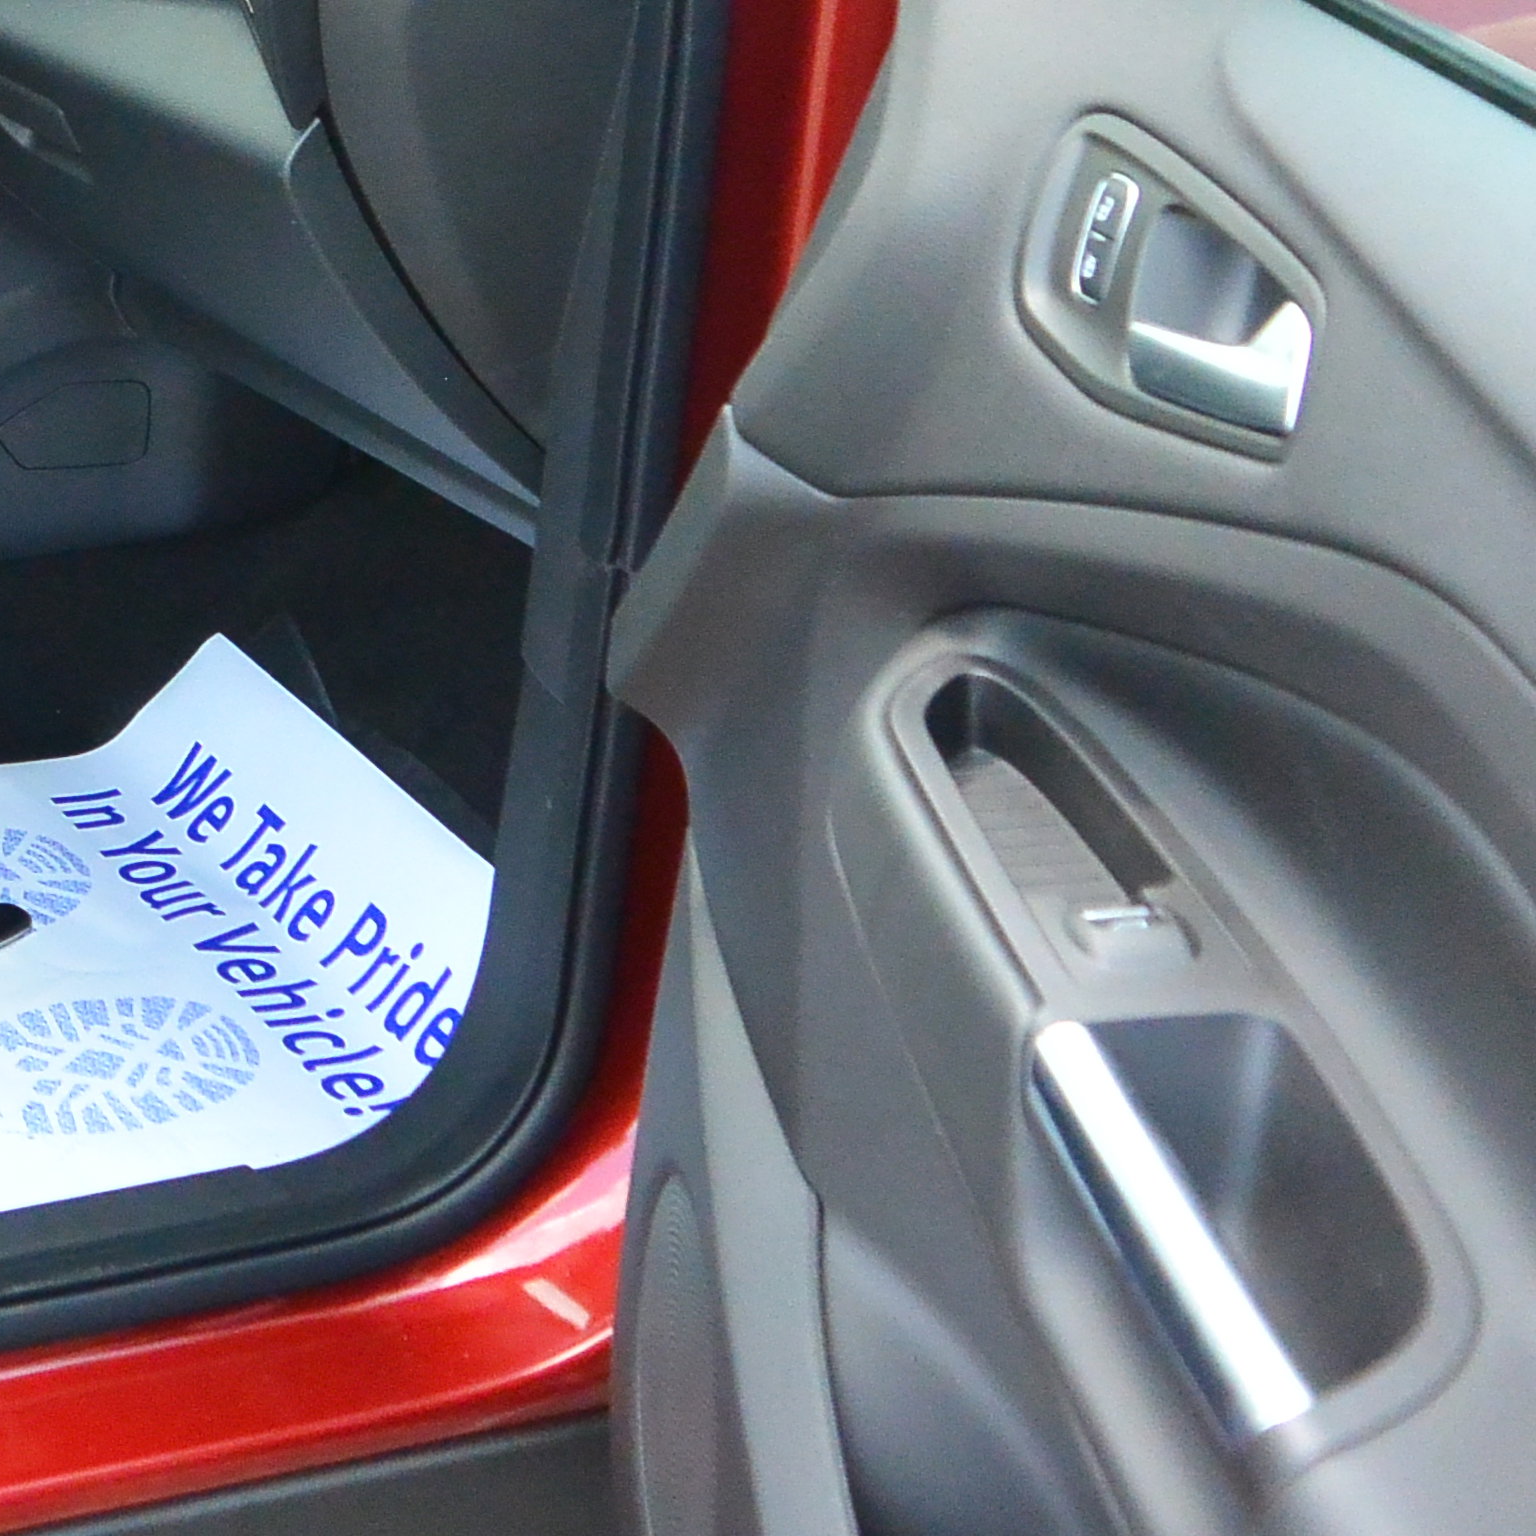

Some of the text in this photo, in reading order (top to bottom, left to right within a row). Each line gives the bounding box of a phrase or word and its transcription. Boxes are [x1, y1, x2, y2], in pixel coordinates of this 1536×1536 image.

[50, 788, 126, 830] In
[99, 830, 226, 921] Your
[151, 741, 463, 1066] We Take Pride
